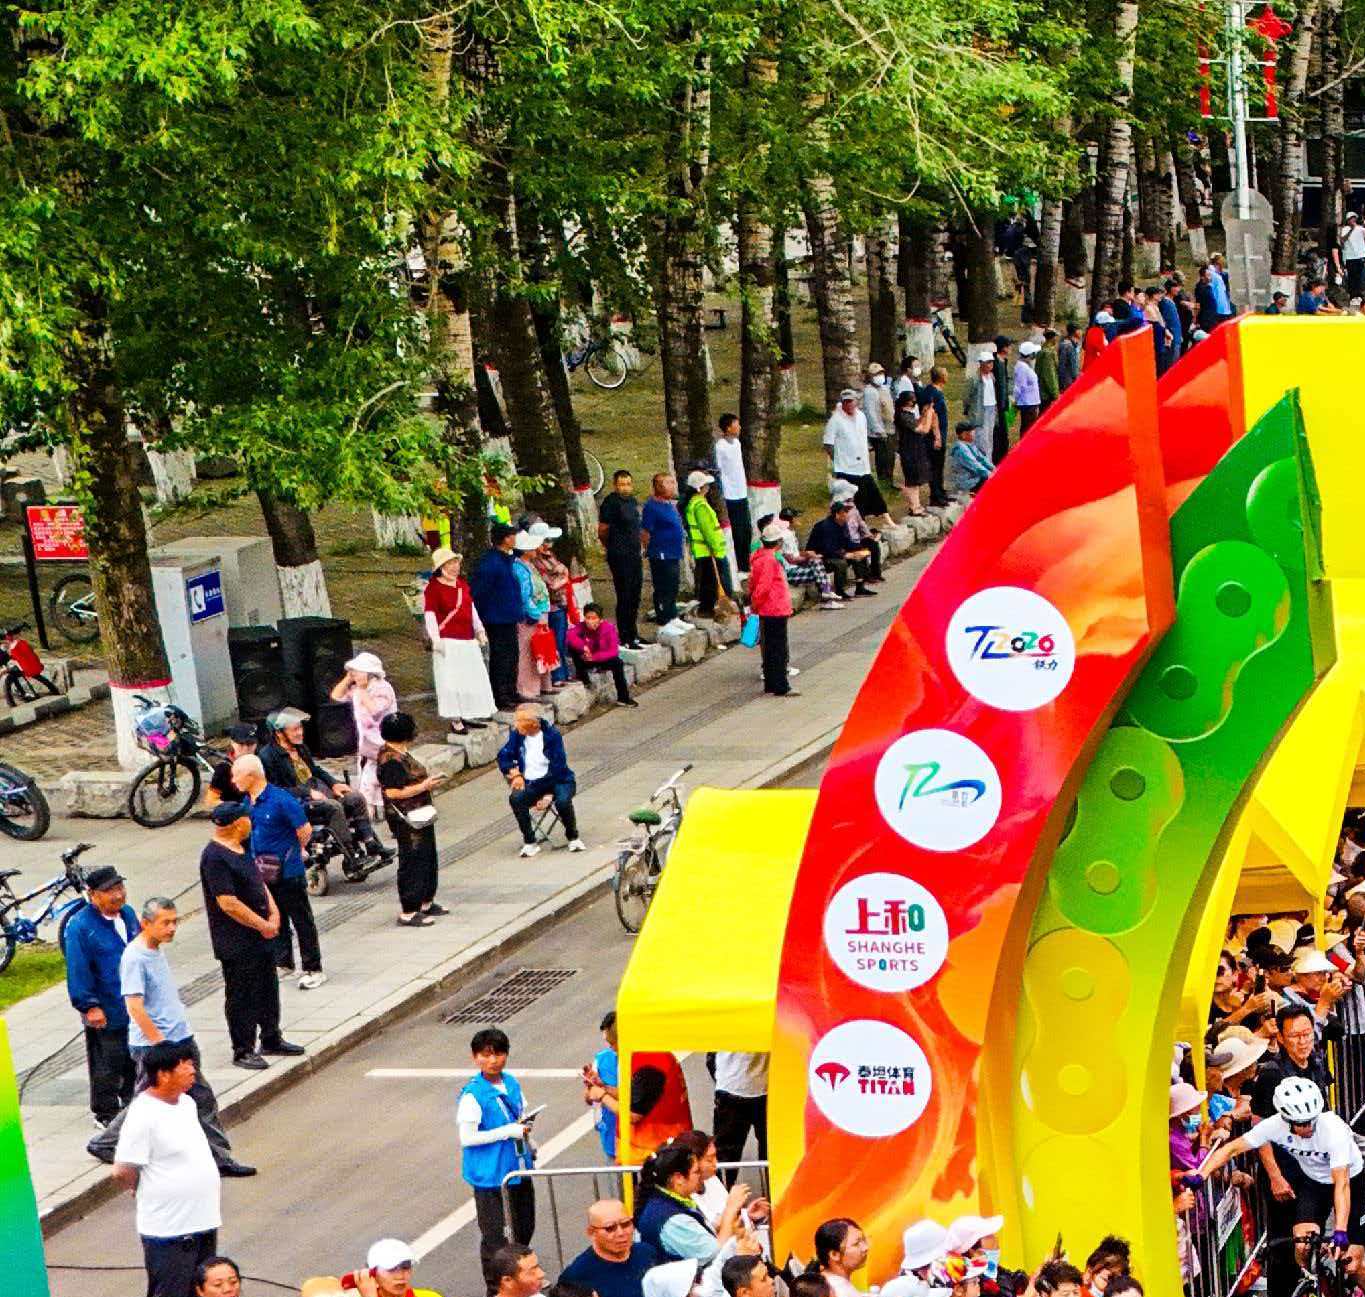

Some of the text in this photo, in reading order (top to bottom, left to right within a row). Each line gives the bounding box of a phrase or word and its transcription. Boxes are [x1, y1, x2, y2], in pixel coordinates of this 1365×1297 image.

[1033, 658, 1059, 672] 铁力
[847, 940, 926, 956] SHANGHE
[856, 957, 920, 972] SPORTS
[857, 1079, 915, 1096] TITAN
